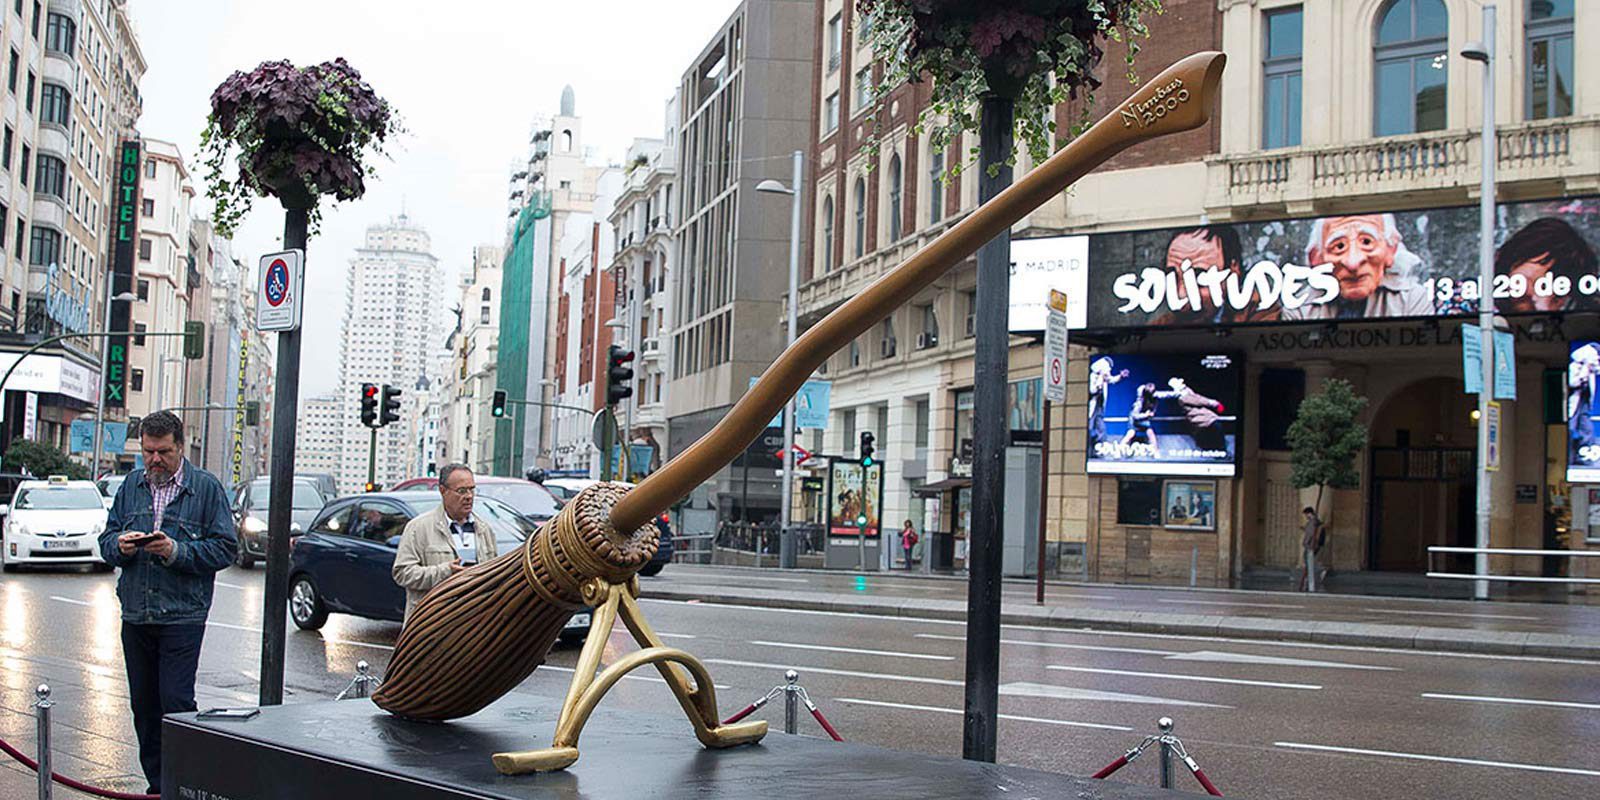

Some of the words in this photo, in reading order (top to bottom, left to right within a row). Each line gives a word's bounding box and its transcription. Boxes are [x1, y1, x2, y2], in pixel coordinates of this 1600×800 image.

[1120, 78, 1183, 128] Nimbus
[1143, 89, 1190, 126] 2000
[120, 148, 138, 241] HOTEL
[1025, 258, 1080, 273] MADRID
[1424, 276, 1455, 302] 13
[1493, 273, 1528, 299] 29
[1534, 271, 1572, 297] de
[1578, 273, 1600, 295] o
[1399, 326, 1428, 346] DE
[1436, 325, 1463, 346] LA
[108, 344, 125, 400] REX
[238, 338, 248, 390] HOTEL
[834, 468, 878, 480] GIFTD
